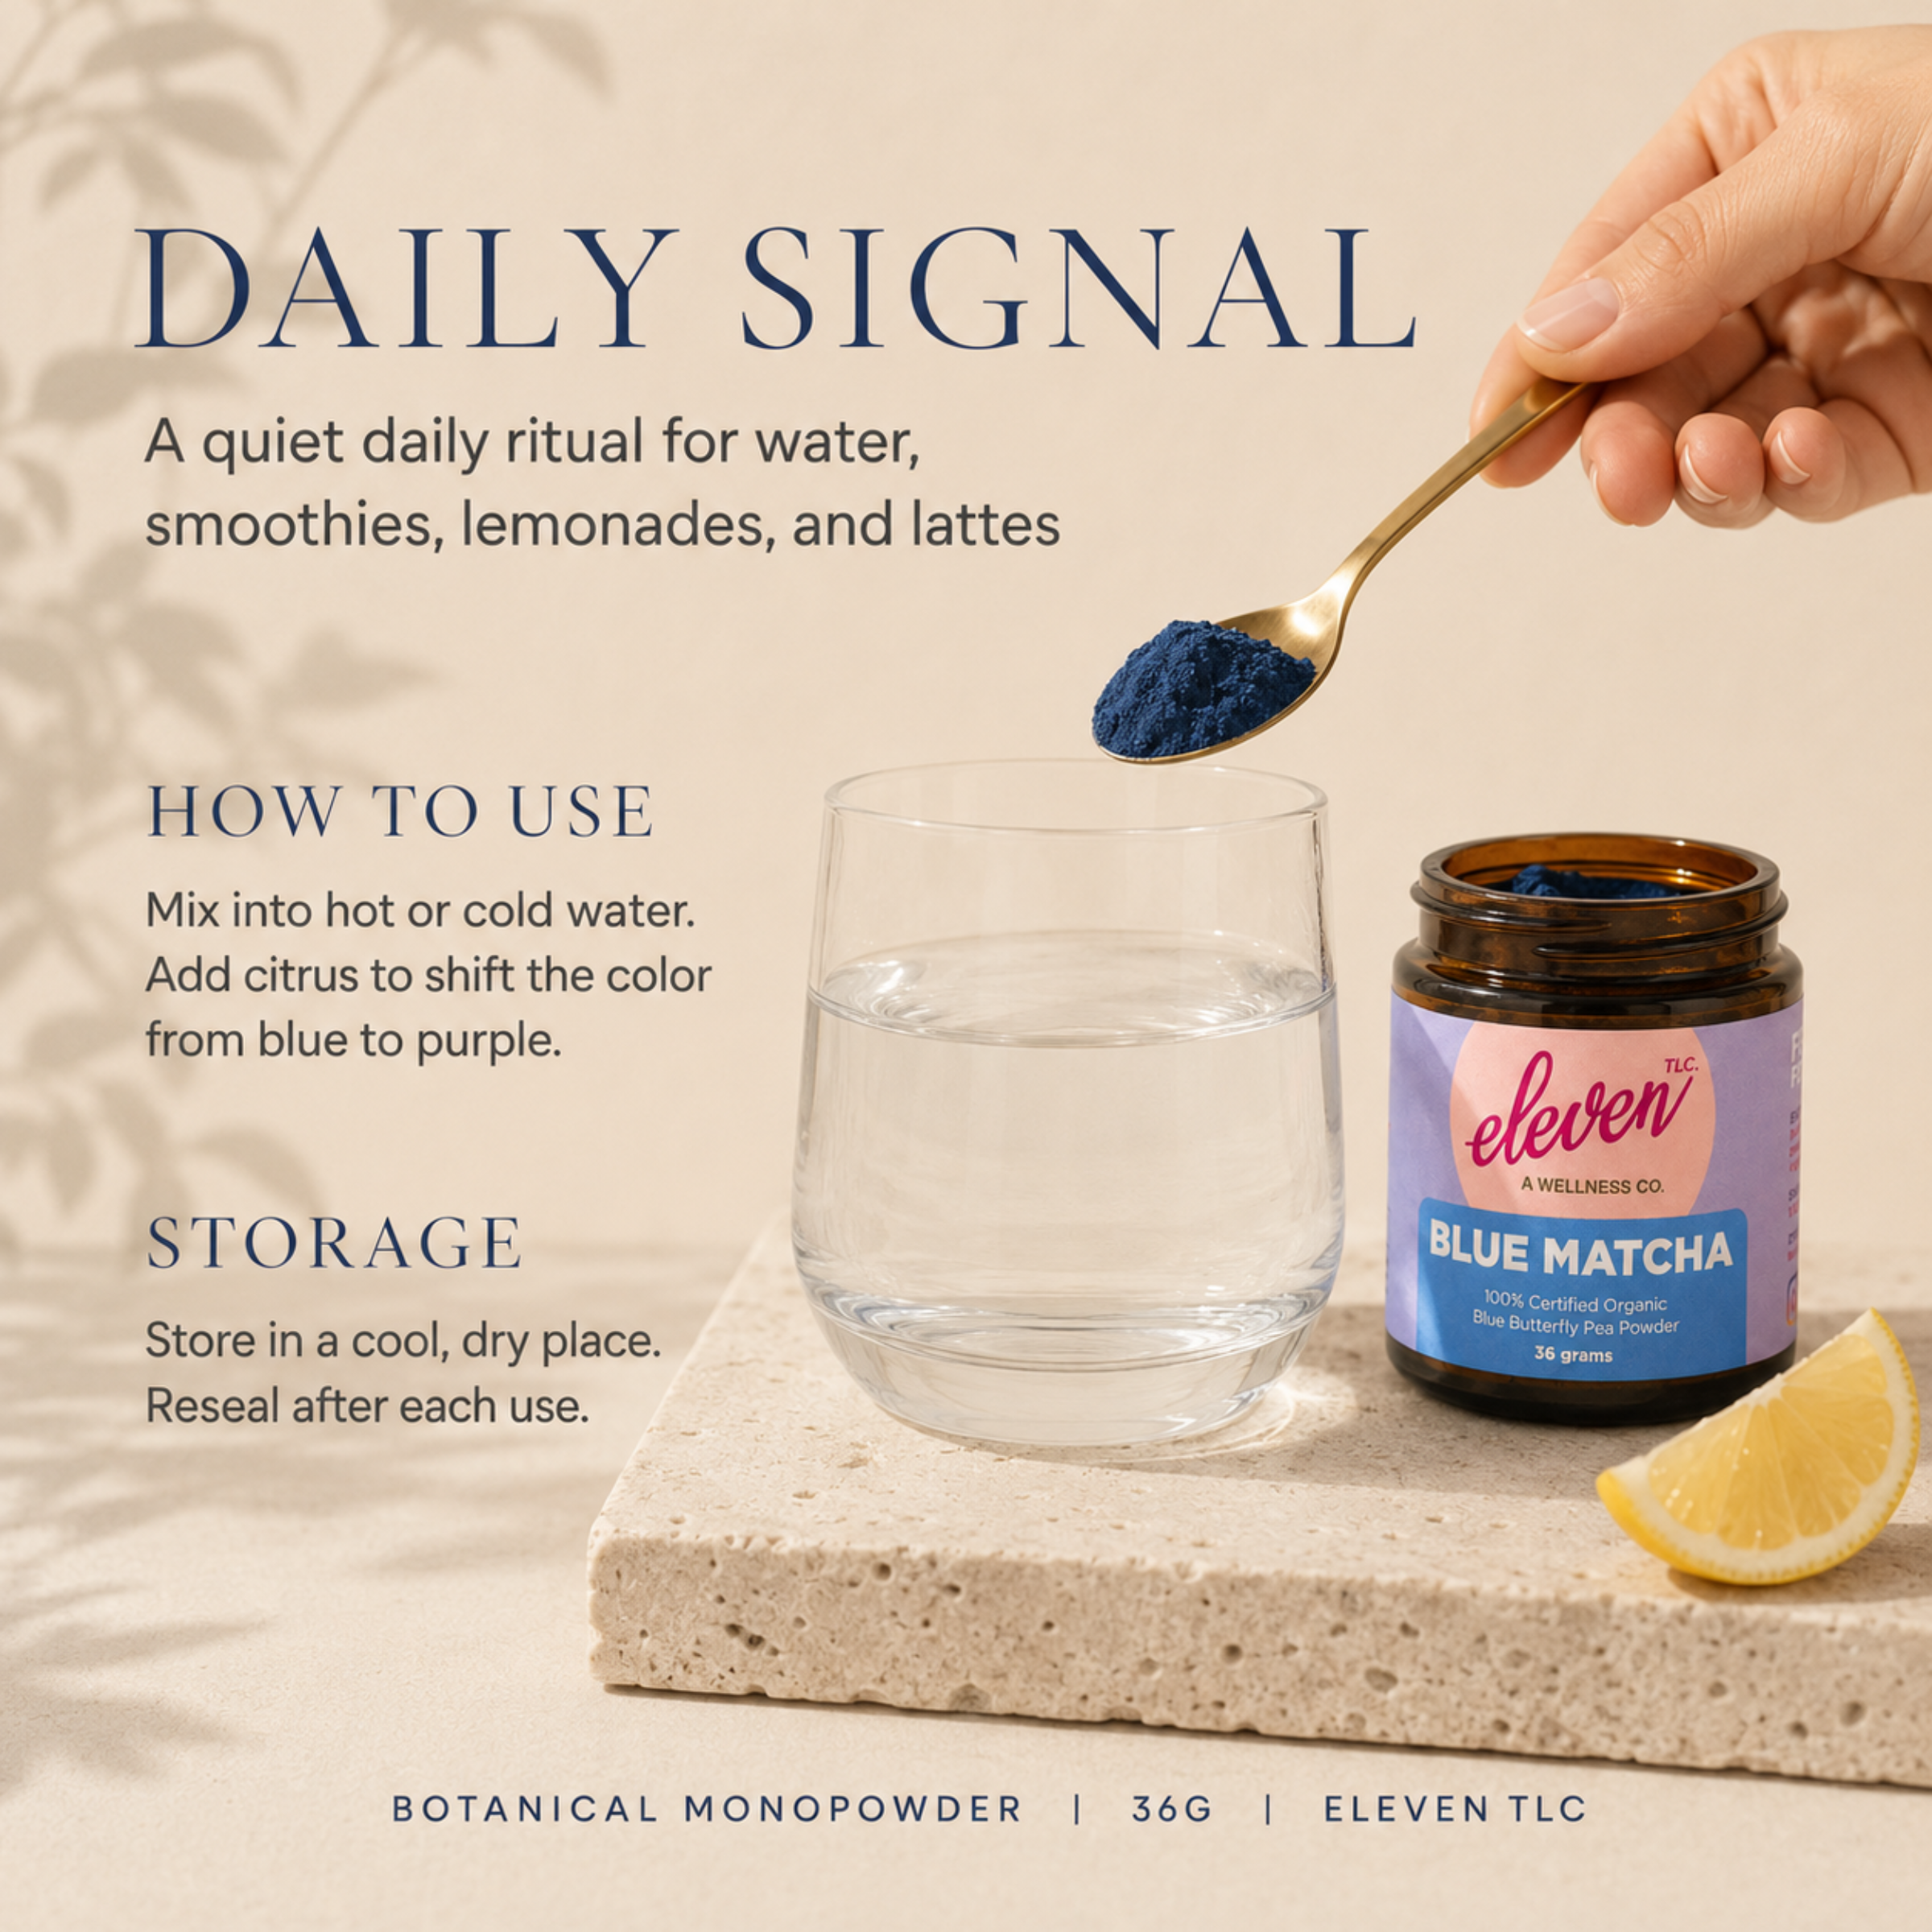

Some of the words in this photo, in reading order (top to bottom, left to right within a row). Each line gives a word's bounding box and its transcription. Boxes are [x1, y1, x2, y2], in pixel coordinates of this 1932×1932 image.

[1665, 1056, 1699, 1074] TLC.
[1465, 1051, 1693, 1166] eleven
[1521, 1176, 1534, 1191] A
[1538, 1177, 1631, 1195] WELLNESS
[1636, 1179, 1665, 1194] CO.
[1430, 1218, 1529, 1272] BLUE
[1543, 1231, 1734, 1277] MATCHA
[1484, 1289, 1524, 1309] 100%
[1529, 1294, 1599, 1313] Certified
[1604, 1297, 1668, 1315] Organic
[1473, 1309, 1505, 1329] Blue
[1509, 1315, 1579, 1337] Butterfly
[1583, 1320, 1614, 1335] Pea
[1619, 1319, 1681, 1335] Powder
[1534, 1345, 1555, 1360] 36
[1560, 1348, 1613, 1364] grams
